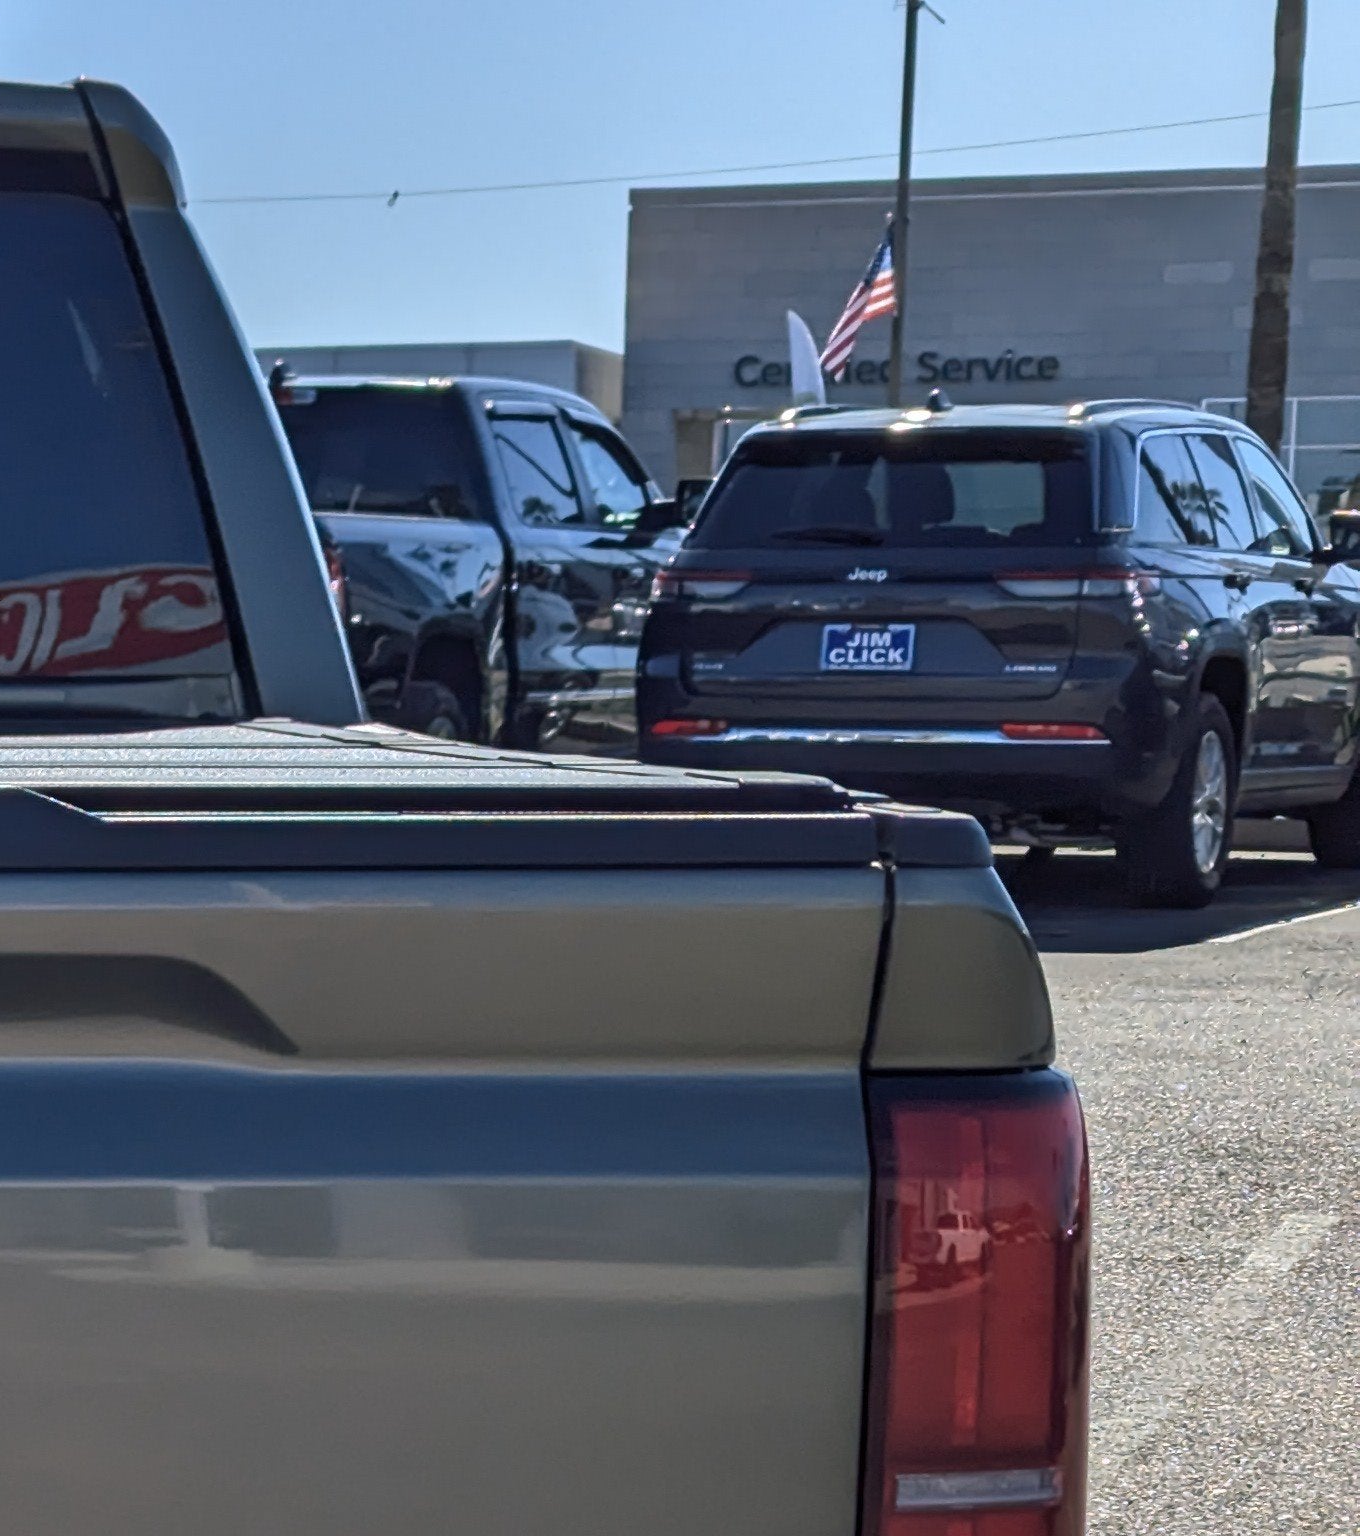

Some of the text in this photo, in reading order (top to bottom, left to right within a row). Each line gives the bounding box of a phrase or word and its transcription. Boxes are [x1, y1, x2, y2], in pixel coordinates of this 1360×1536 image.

[917, 349, 1060, 383] Service
[848, 567, 888, 582] Jeep
[846, 632, 892, 647] JIM
[829, 647, 905, 663] CLICK
